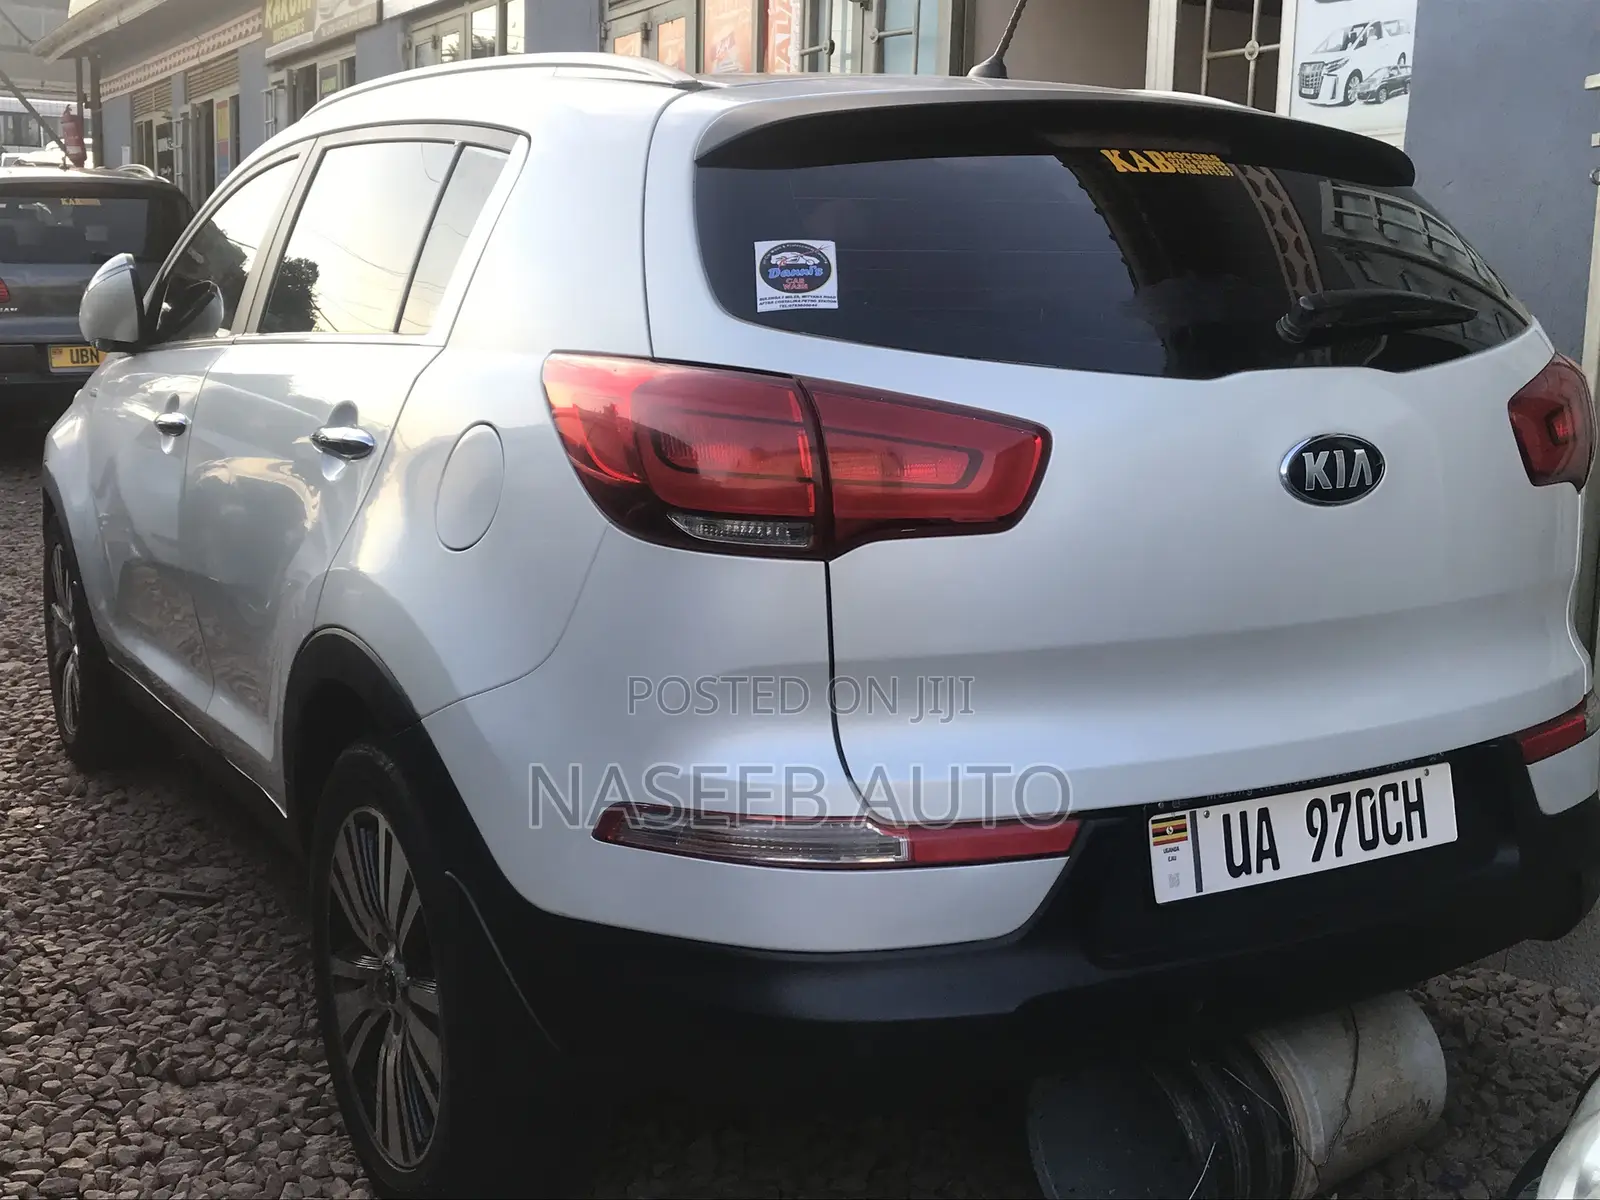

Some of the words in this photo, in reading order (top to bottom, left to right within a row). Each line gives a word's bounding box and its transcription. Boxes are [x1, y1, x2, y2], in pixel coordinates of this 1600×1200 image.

[1100, 150, 1177, 173] KAB
[70, 348, 100, 364] UBN
[1302, 449, 1372, 491] KIA
[1222, 806, 1281, 878] UA
[1305, 777, 1428, 862] 970CH
